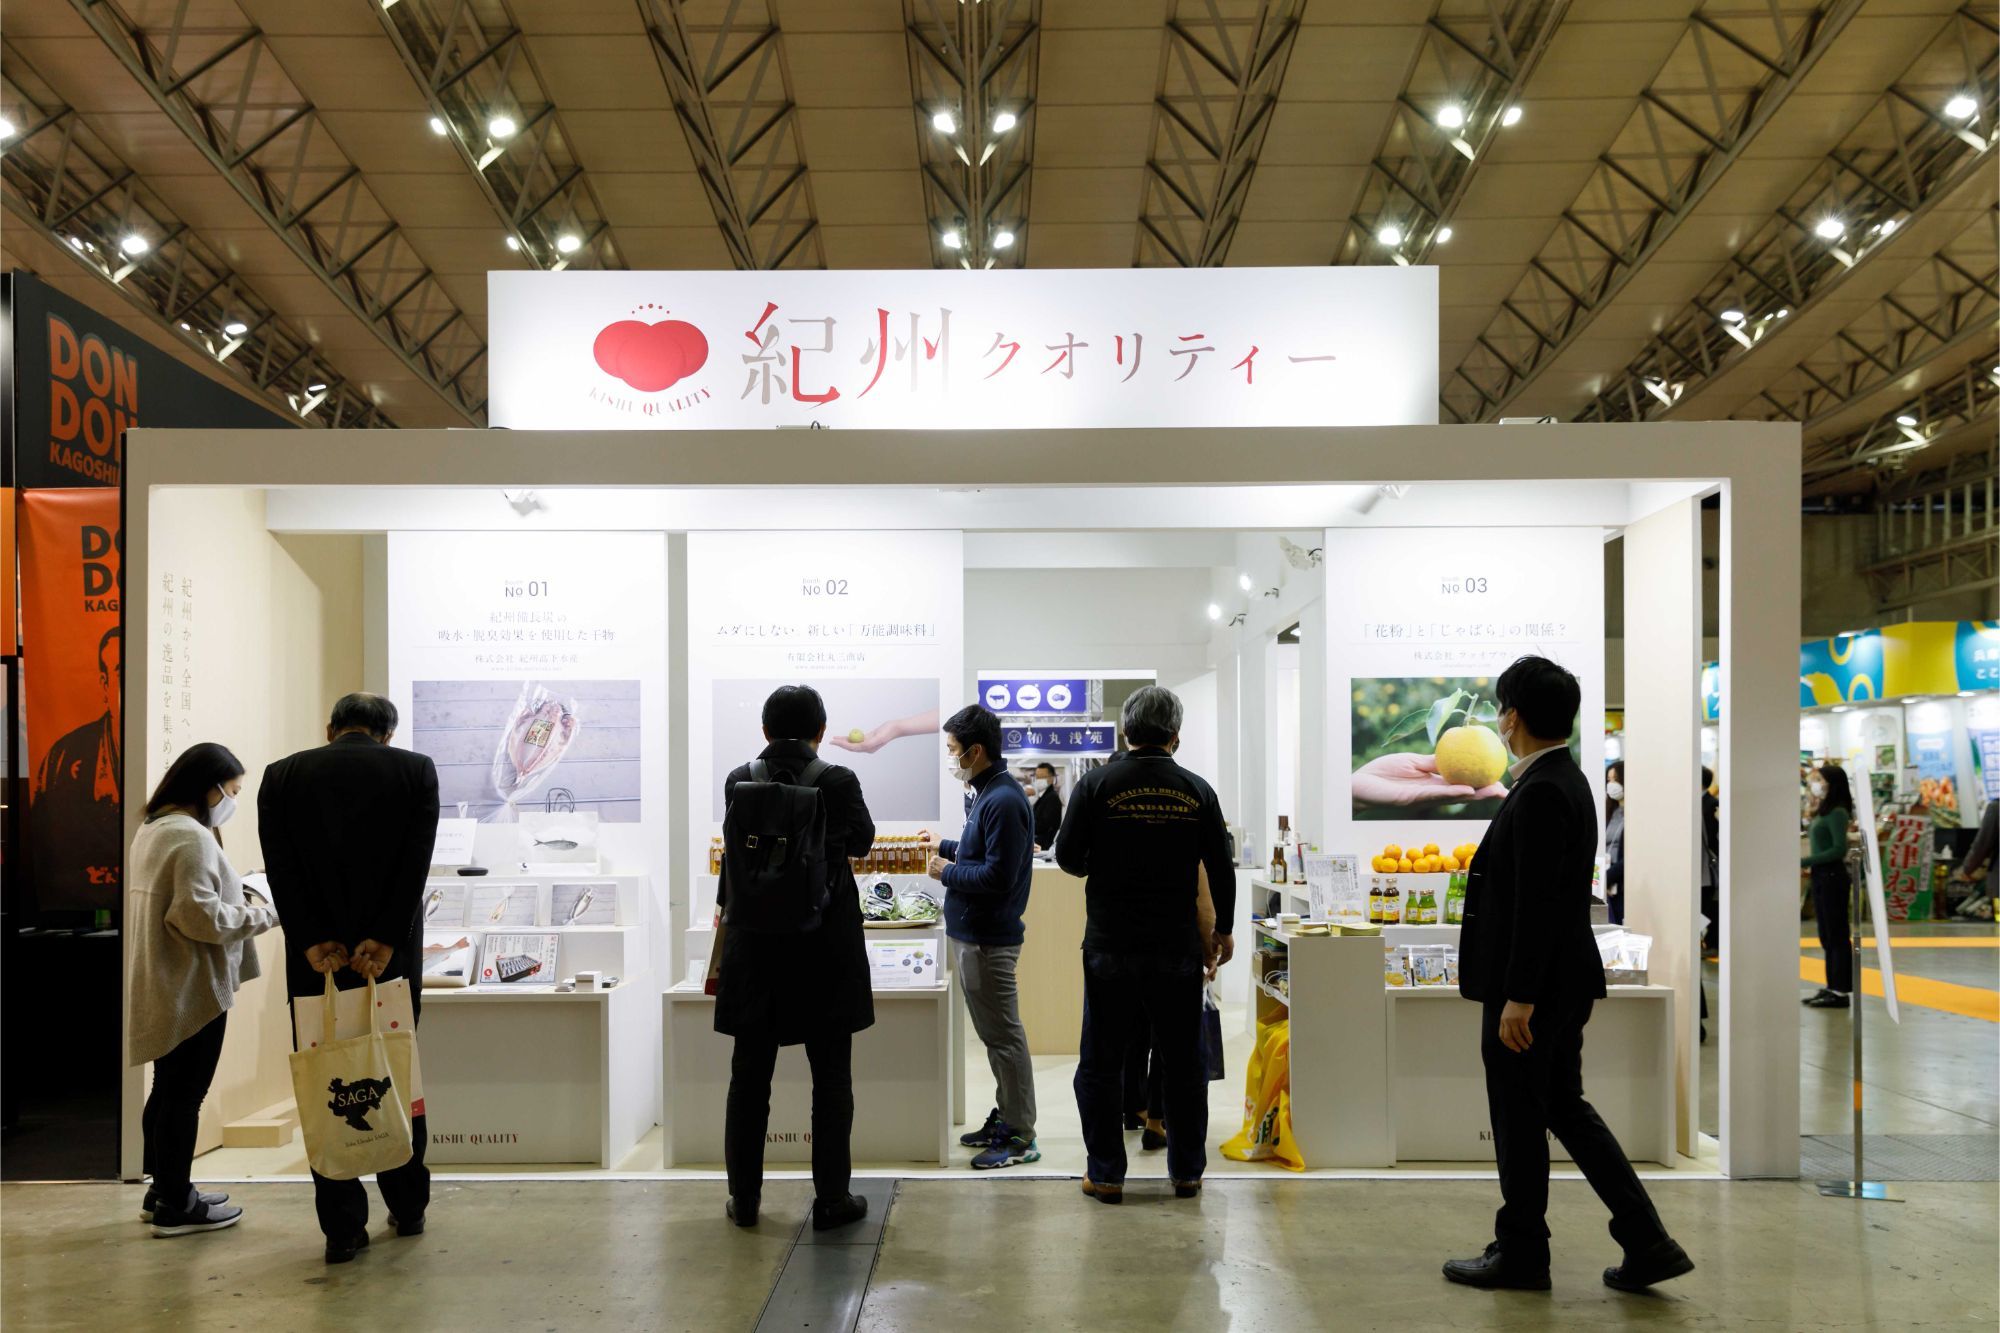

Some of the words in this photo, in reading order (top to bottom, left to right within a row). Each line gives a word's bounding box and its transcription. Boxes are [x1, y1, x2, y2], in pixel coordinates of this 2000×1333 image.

[740, 301, 1337, 409] 紀州クオリティー
[48, 313, 138, 414] DON
[643, 385, 712, 416] QUALITY
[528, 581, 548, 597] 01
[826, 579, 849, 595] 02
[1465, 577, 1488, 593] 03
[337, 1086, 380, 1108] SAGA
[432, 1133, 467, 1144] KISHU
[470, 1133, 519, 1145] QUALITY
[766, 1132, 800, 1143] KISHU
